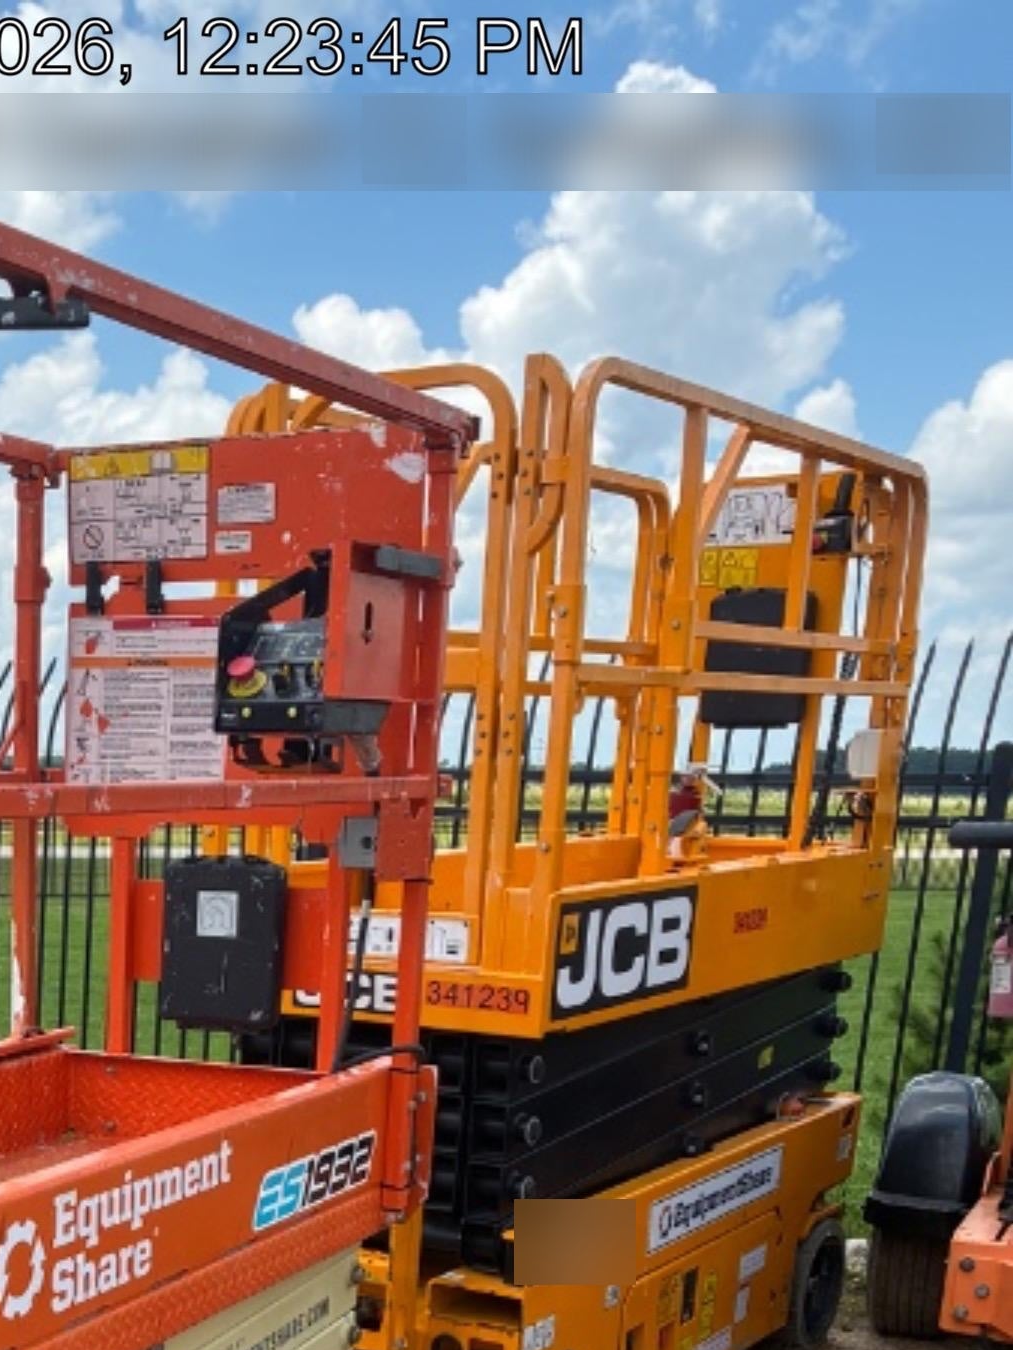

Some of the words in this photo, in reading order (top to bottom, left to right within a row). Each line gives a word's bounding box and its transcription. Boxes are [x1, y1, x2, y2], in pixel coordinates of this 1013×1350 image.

[556, 896, 692, 1008] JCB
[426, 980, 530, 1015] 341239
[53, 1140, 233, 1248] Equipment
[253, 1130, 376, 1230] ES1932
[674, 1166, 773, 1229] EquipmentShare
[52, 1238, 153, 1313] Share
